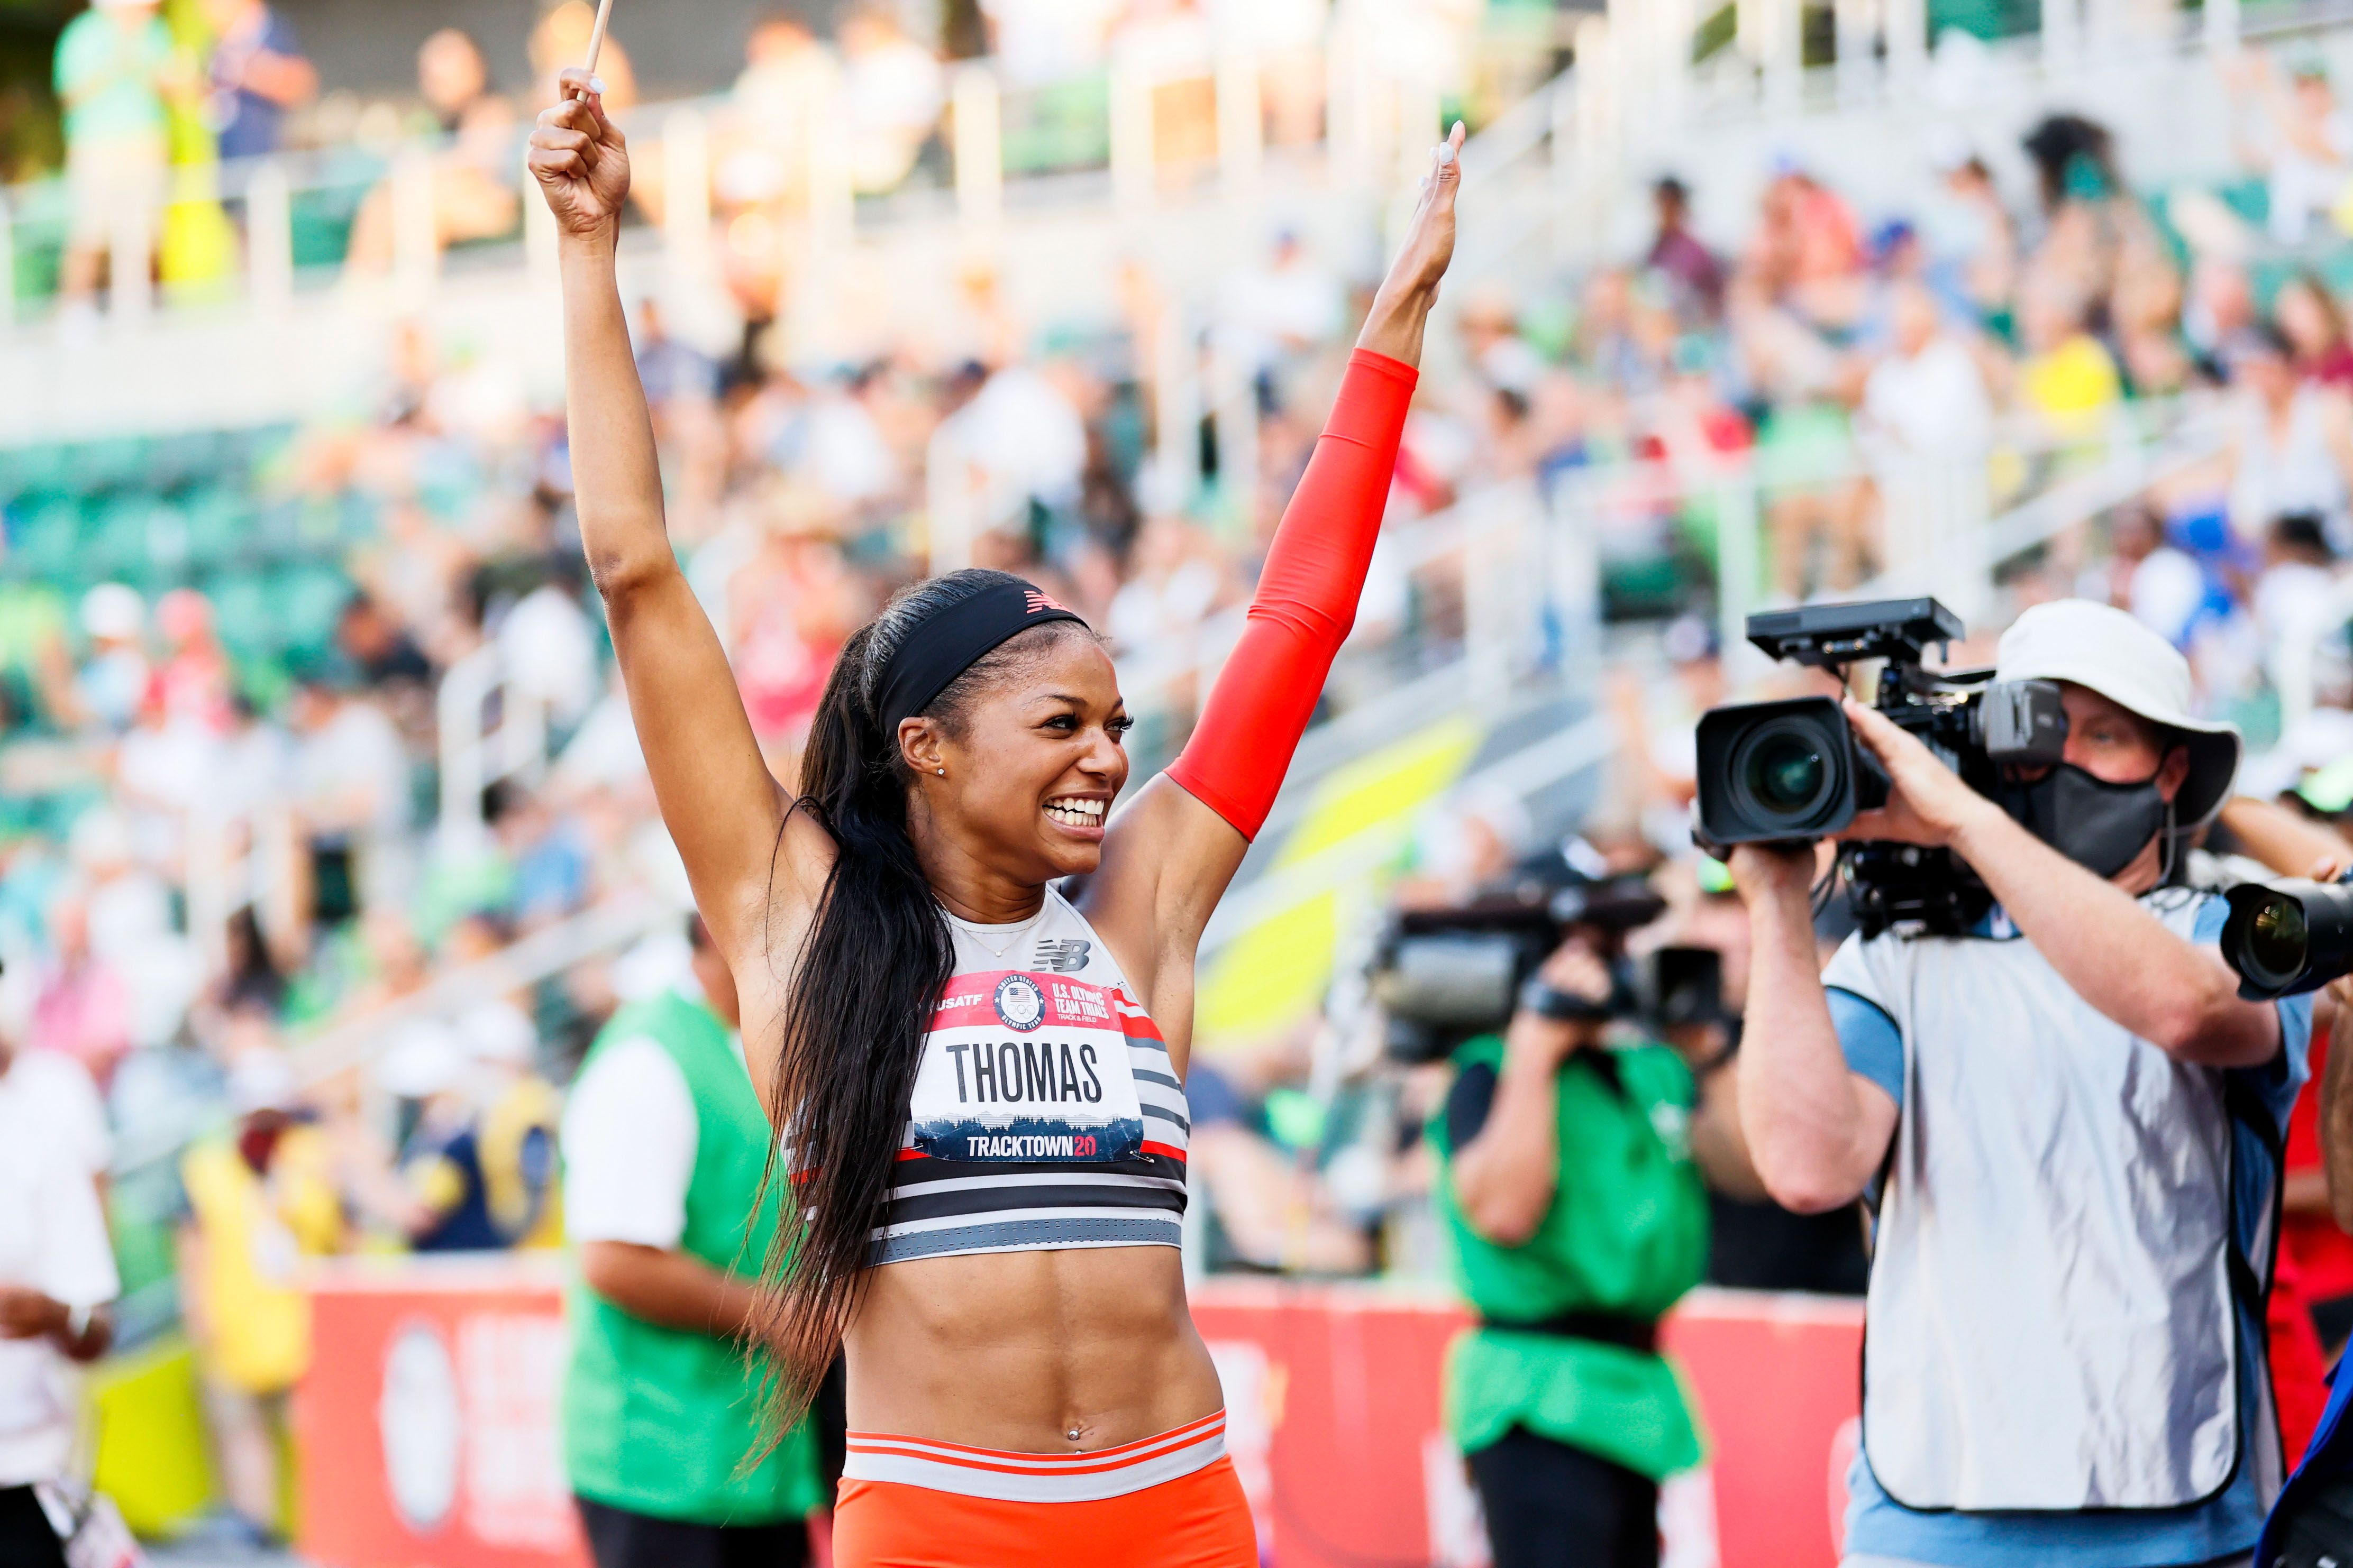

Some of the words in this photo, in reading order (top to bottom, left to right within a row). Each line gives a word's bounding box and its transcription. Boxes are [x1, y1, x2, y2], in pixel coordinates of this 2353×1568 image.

[1030, 939, 1090, 972] NB
[998, 975, 1017, 990] UNITED
[1019, 976, 1038, 992] STATES
[1052, 983, 1071, 999] U.S.
[1070, 985, 1105, 1006] OLYMPIC
[1054, 998, 1081, 1014] TEAM
[1080, 1002, 1109, 1020] TRIALS
[1001, 1015, 1026, 1030] OLYMPIC
[1027, 1015, 1042, 1029] TEAM
[946, 1042, 1102, 1103] THOMAS
